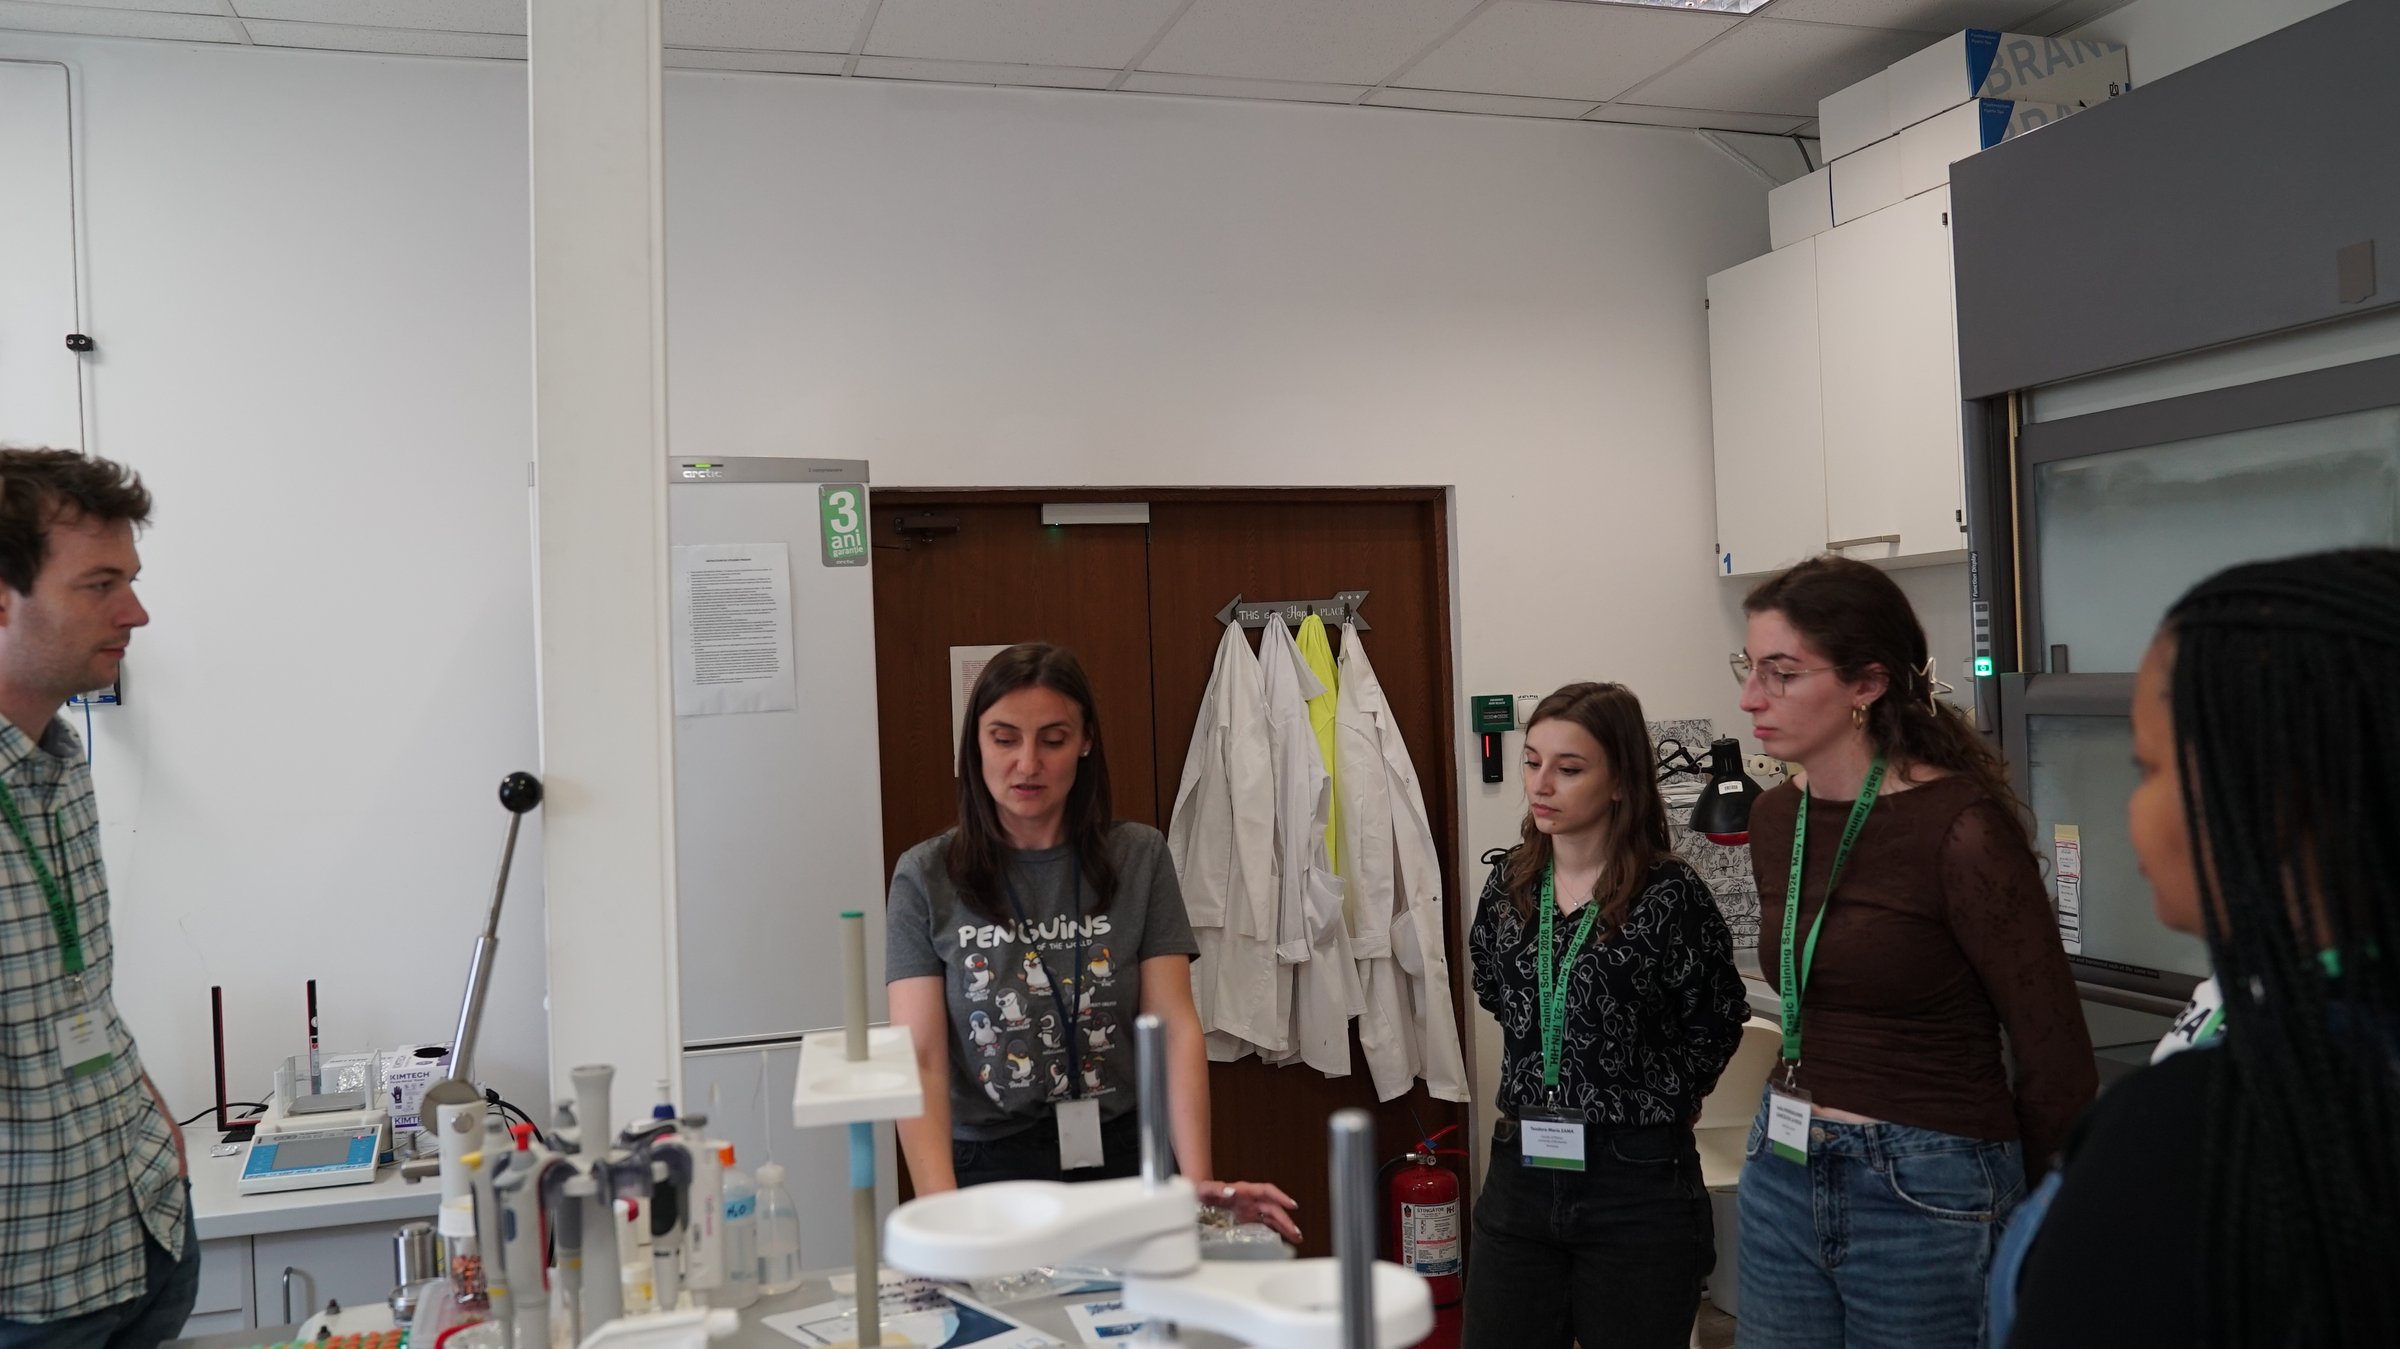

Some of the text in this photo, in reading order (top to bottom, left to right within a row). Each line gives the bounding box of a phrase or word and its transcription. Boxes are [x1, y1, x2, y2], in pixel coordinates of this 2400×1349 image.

[1986, 38, 2127, 97] BRAN
[682, 469, 723, 479] arctic
[829, 491, 858, 533] 3
[831, 529, 862, 550] ani
[1723, 552, 1732, 574] 1
[1239, 610, 1260, 621] THIS
[1863, 766, 1885, 800] Basic
[1843, 800, 1868, 846] Training
[1791, 843, 1803, 866] May
[1541, 905, 1552, 925] May
[1577, 909, 1597, 940] School
[1781, 904, 1794, 945] School
[1050, 941, 1063, 950] THE
[1540, 954, 1550, 989] School
[1557, 967, 1568, 989] May
[1782, 948, 1794, 999] Training
[1542, 991, 1552, 1035] Training
[389, 1071, 430, 1080] KIMTECH
